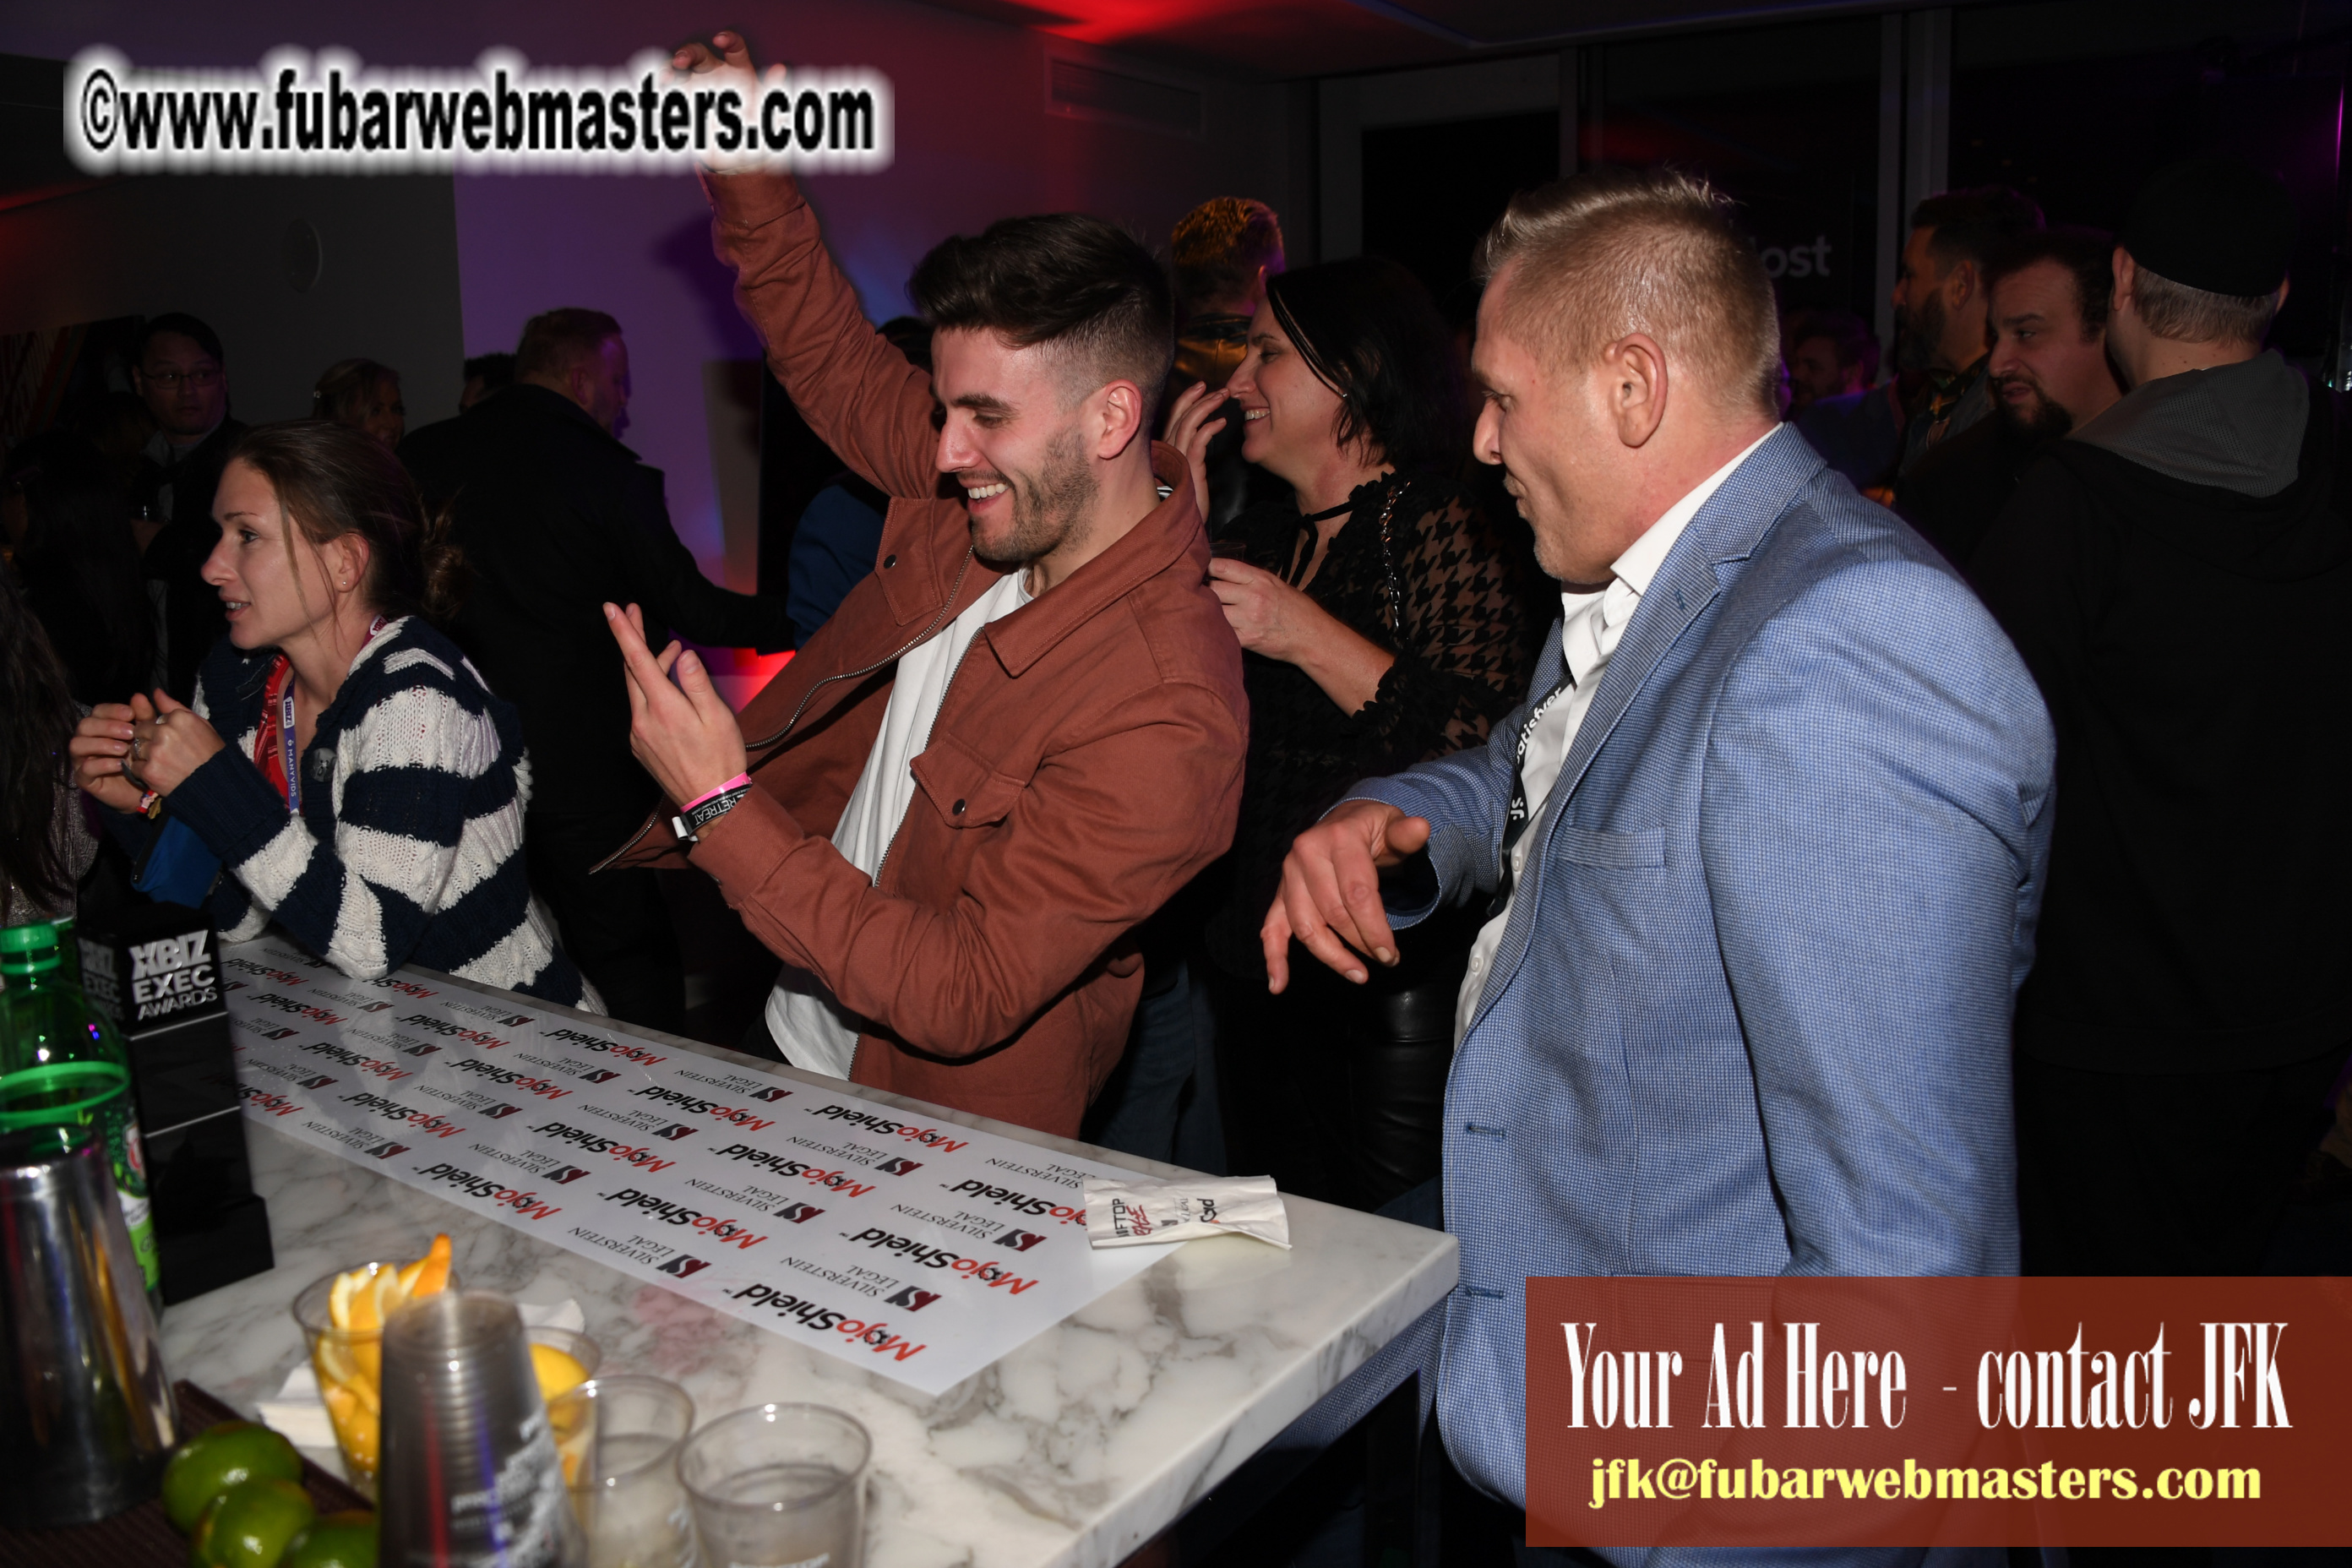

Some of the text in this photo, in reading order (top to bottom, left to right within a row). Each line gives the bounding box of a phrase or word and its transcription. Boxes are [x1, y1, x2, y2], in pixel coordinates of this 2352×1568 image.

[1756, 234, 1832, 280] ost
[287, 750, 297, 798] MANYVIDS
[128, 929, 211, 980] XBIZ
[132, 965, 215, 1004] EXEC
[138, 987, 217, 1021] AWARDS
